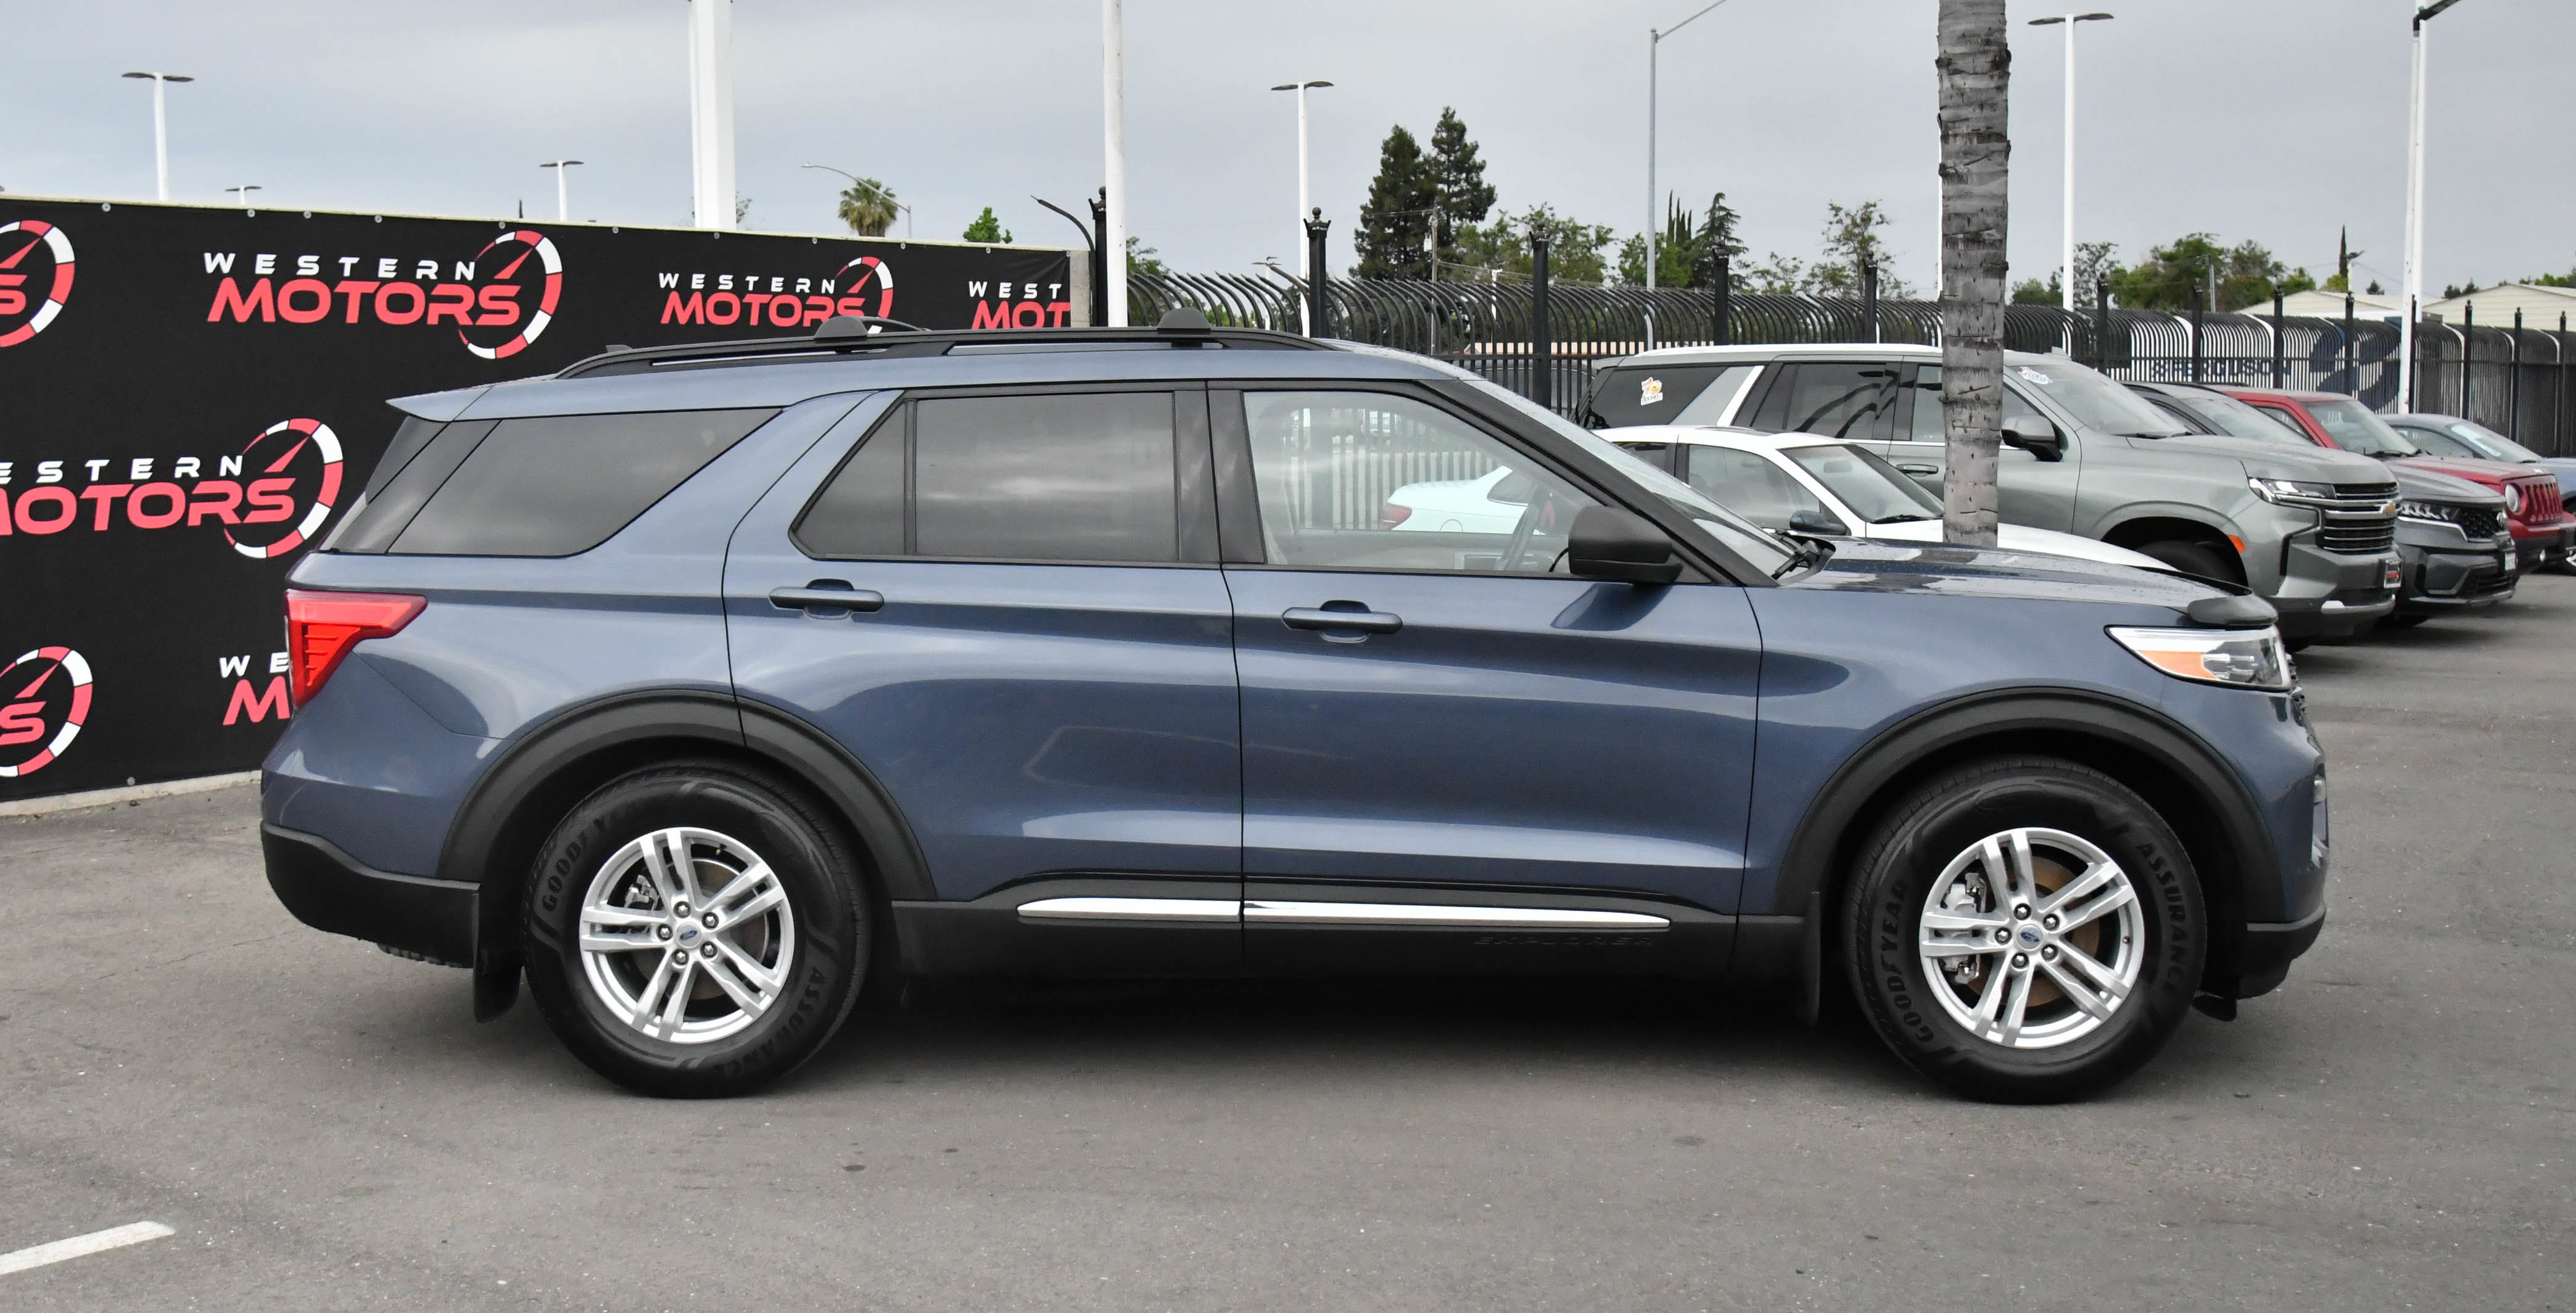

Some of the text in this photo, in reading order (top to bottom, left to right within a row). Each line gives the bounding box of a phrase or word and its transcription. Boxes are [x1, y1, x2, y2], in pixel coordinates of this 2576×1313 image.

[204, 252, 476, 281] WESTERN
[658, 273, 836, 294] WESTERN
[207, 276, 521, 326] MOTORS
[661, 291, 866, 327] MOTORS
[968, 281, 1062, 299] WEST
[0, 477, 295, 536] OTORS
[2135, 842, 2189, 993] ASSURANCE
[1880, 879, 1934, 1043] GOODYEAR
